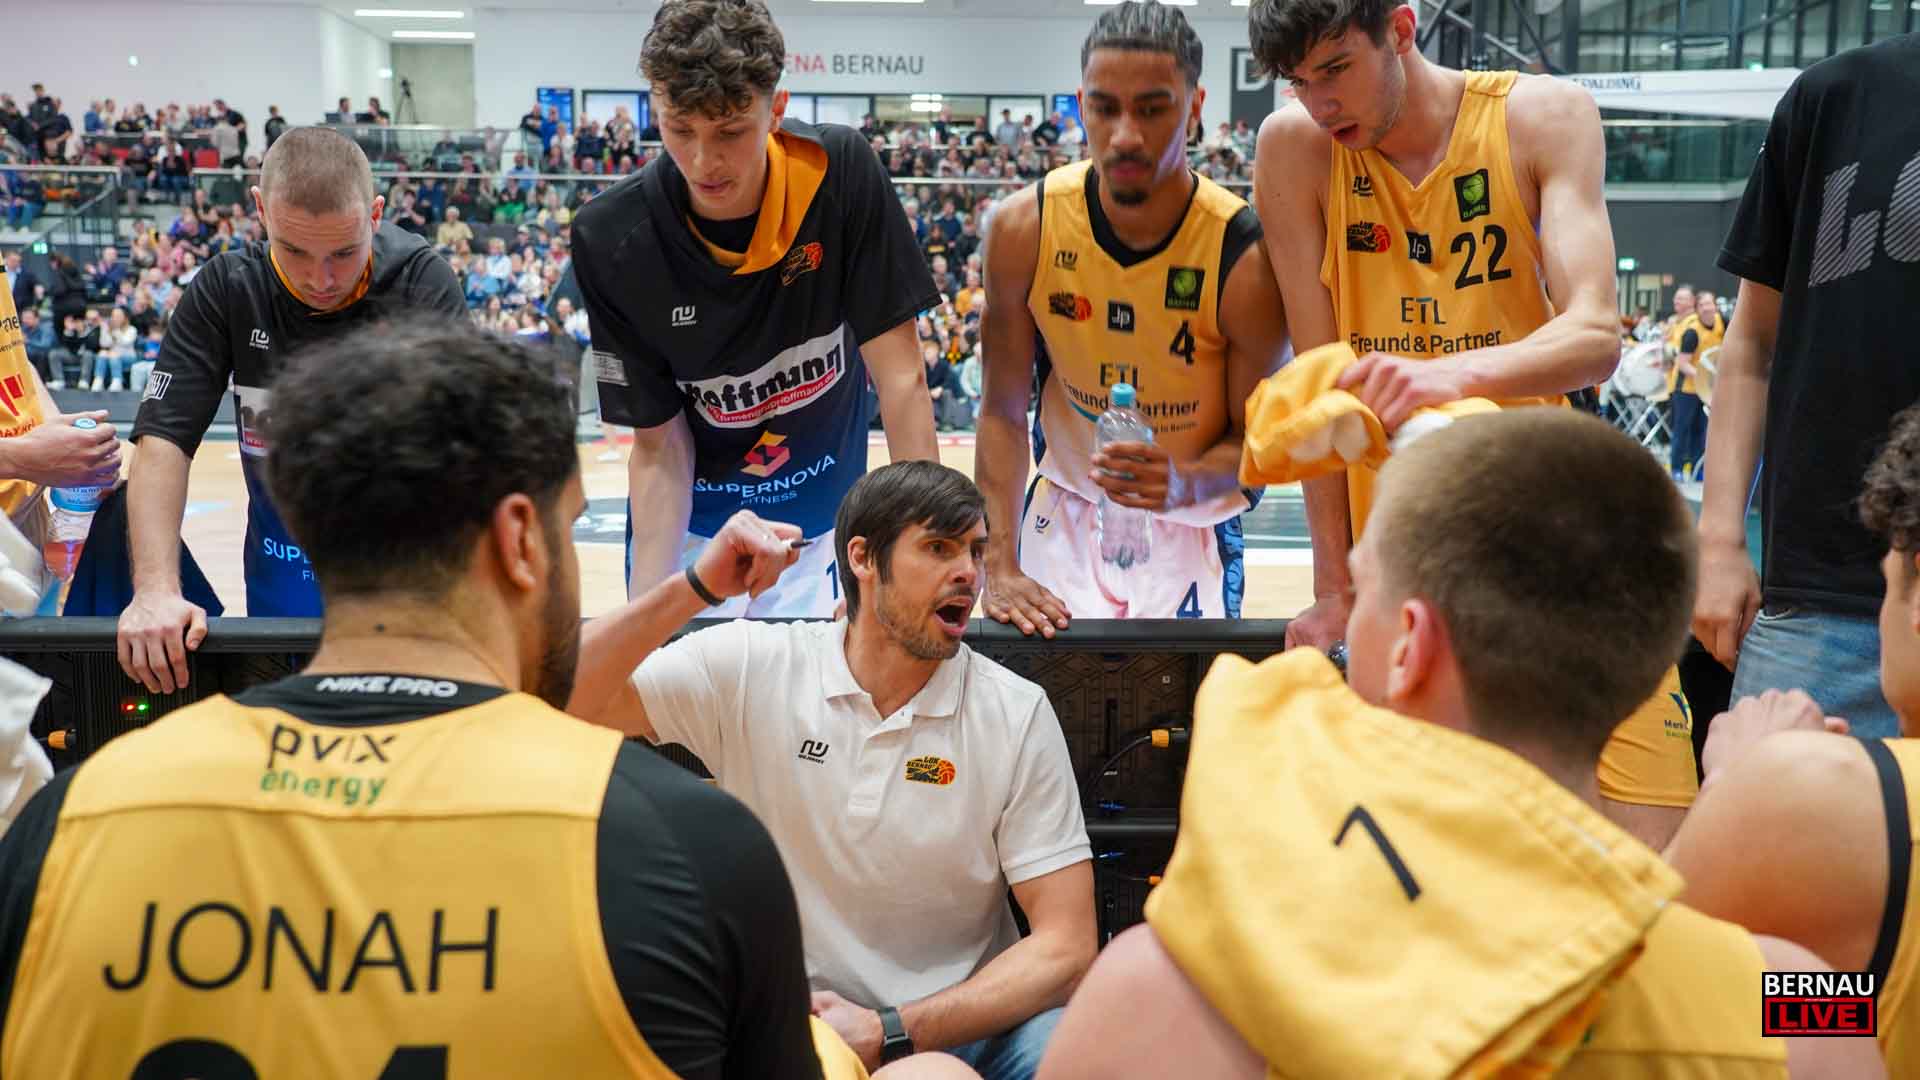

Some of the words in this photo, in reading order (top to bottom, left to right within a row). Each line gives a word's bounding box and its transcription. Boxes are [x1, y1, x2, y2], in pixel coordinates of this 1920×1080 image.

[783, 53, 826, 74] ENA
[832, 54, 924, 75] BERNAU
[1450, 223, 1512, 291] 22
[1401, 296, 1447, 325] ETL
[1169, 319, 1196, 366] 4
[685, 343, 841, 412] hoffmann
[1063, 378, 1109, 410] reund
[1100, 362, 1144, 393] ETL
[694, 454, 836, 499] SUPERNOVA
[739, 491, 798, 506] FITNESS
[1176, 581, 1204, 619] 4
[315, 676, 391, 692] NIKE
[387, 676, 459, 698] PRO
[259, 768, 387, 806] energy
[102, 902, 499, 993] JONAH
